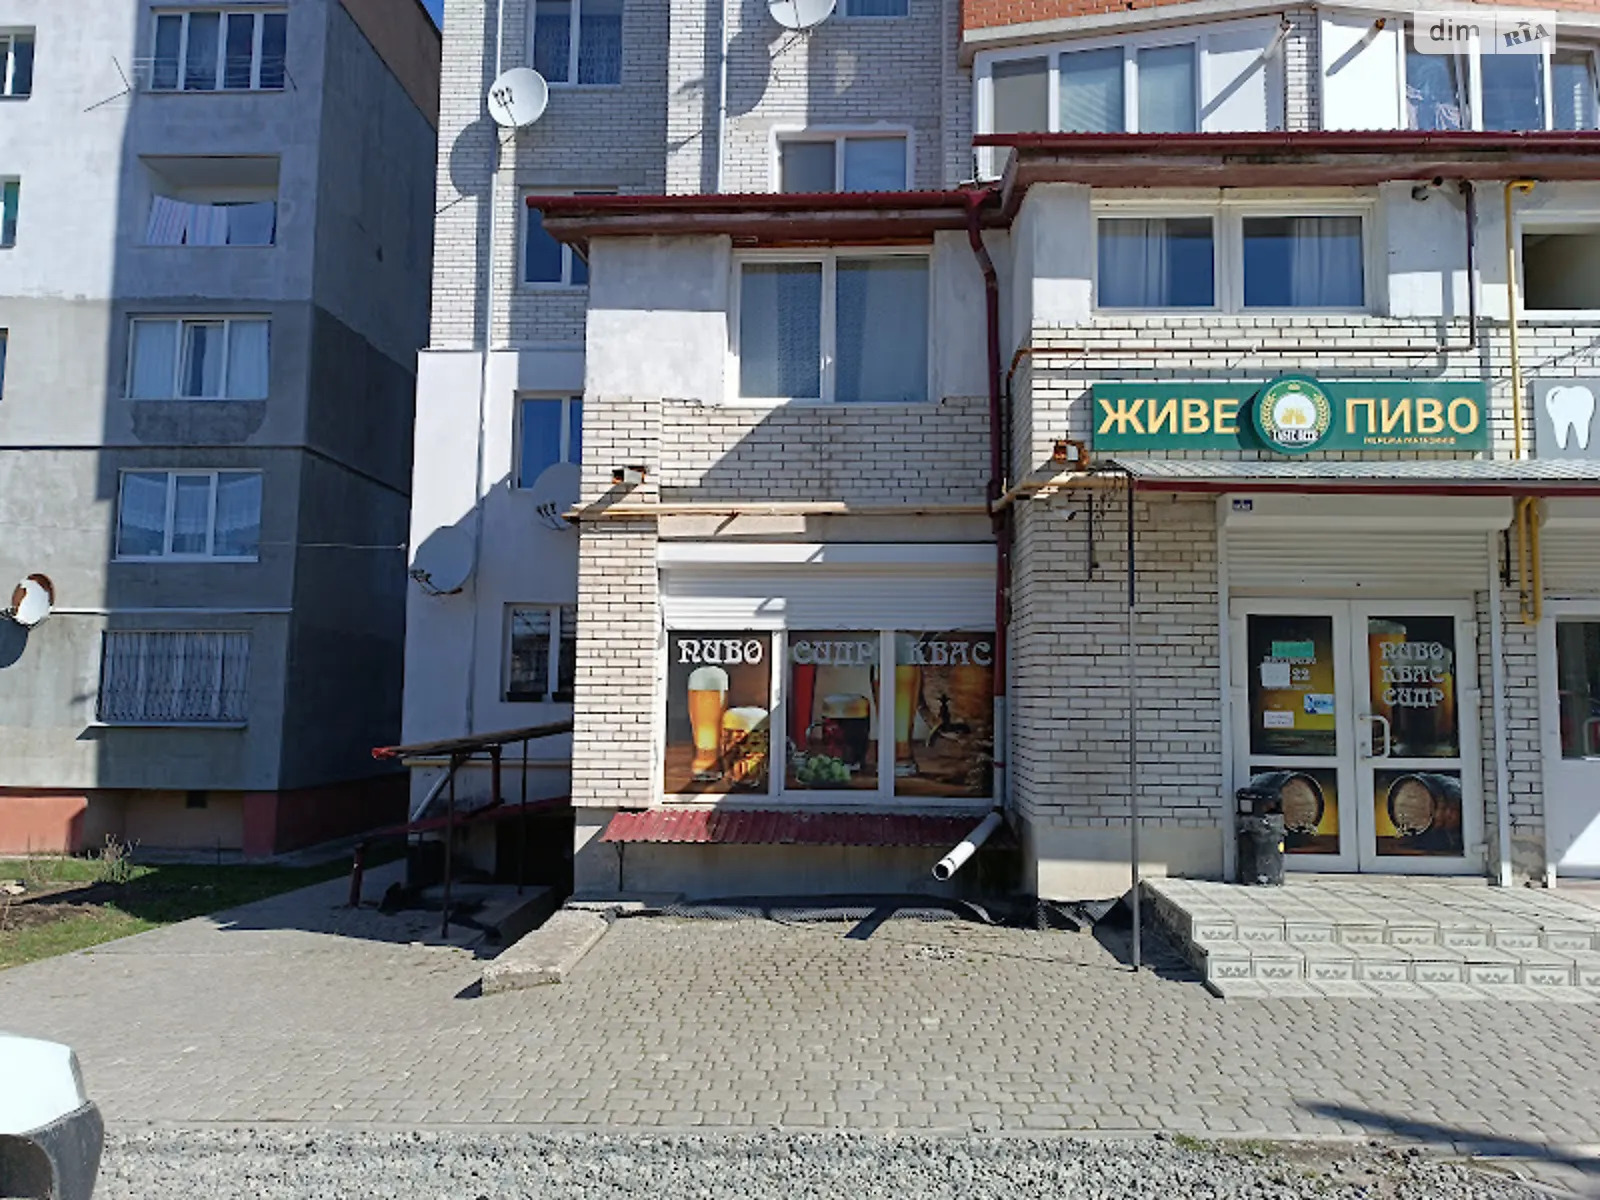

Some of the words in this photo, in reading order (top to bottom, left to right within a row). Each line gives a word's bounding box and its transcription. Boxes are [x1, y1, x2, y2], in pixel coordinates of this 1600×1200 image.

[1097, 398, 1240, 434] ЖИВЕ
[1345, 397, 1480, 434] ПИВО
[677, 639, 763, 665] ПИВО
[793, 639, 873, 667] СИДР
[906, 641, 991, 666] КВАС
[1380, 642, 1444, 660] ПИВО
[1380, 666, 1445, 683] КВАС
[1382, 688, 1445, 708] СИДР
